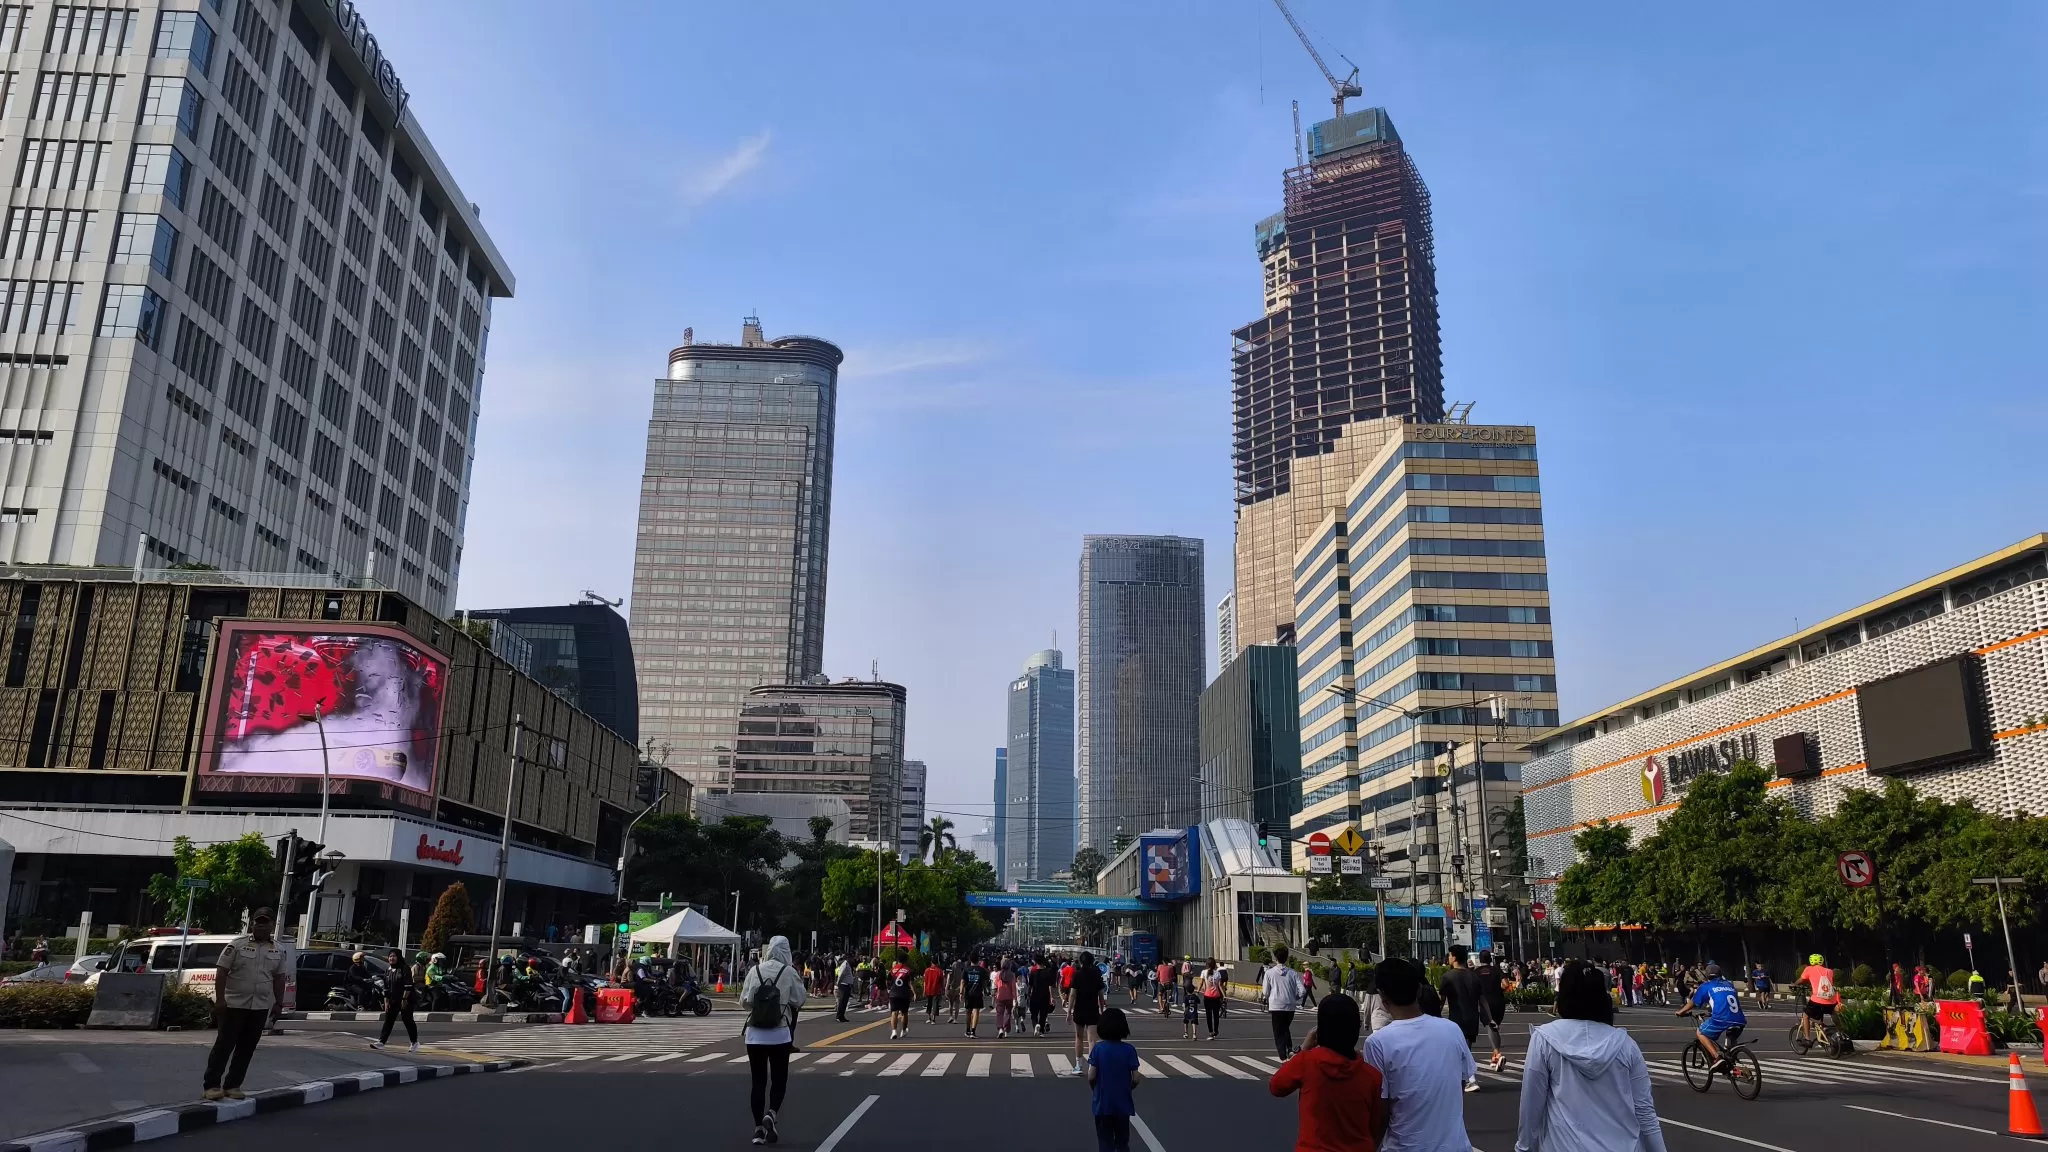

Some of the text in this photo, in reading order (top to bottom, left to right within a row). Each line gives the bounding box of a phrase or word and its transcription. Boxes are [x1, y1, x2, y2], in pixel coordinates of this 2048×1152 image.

[324, 0, 410, 130] urney
[1414, 427, 1525, 442] FOUR POINTS
[1668, 732, 1759, 785] BAWASLU
[895, 973, 904, 987] 6
[1189, 1003, 1195, 1013] 5
[1726, 994, 1739, 1014] 9
